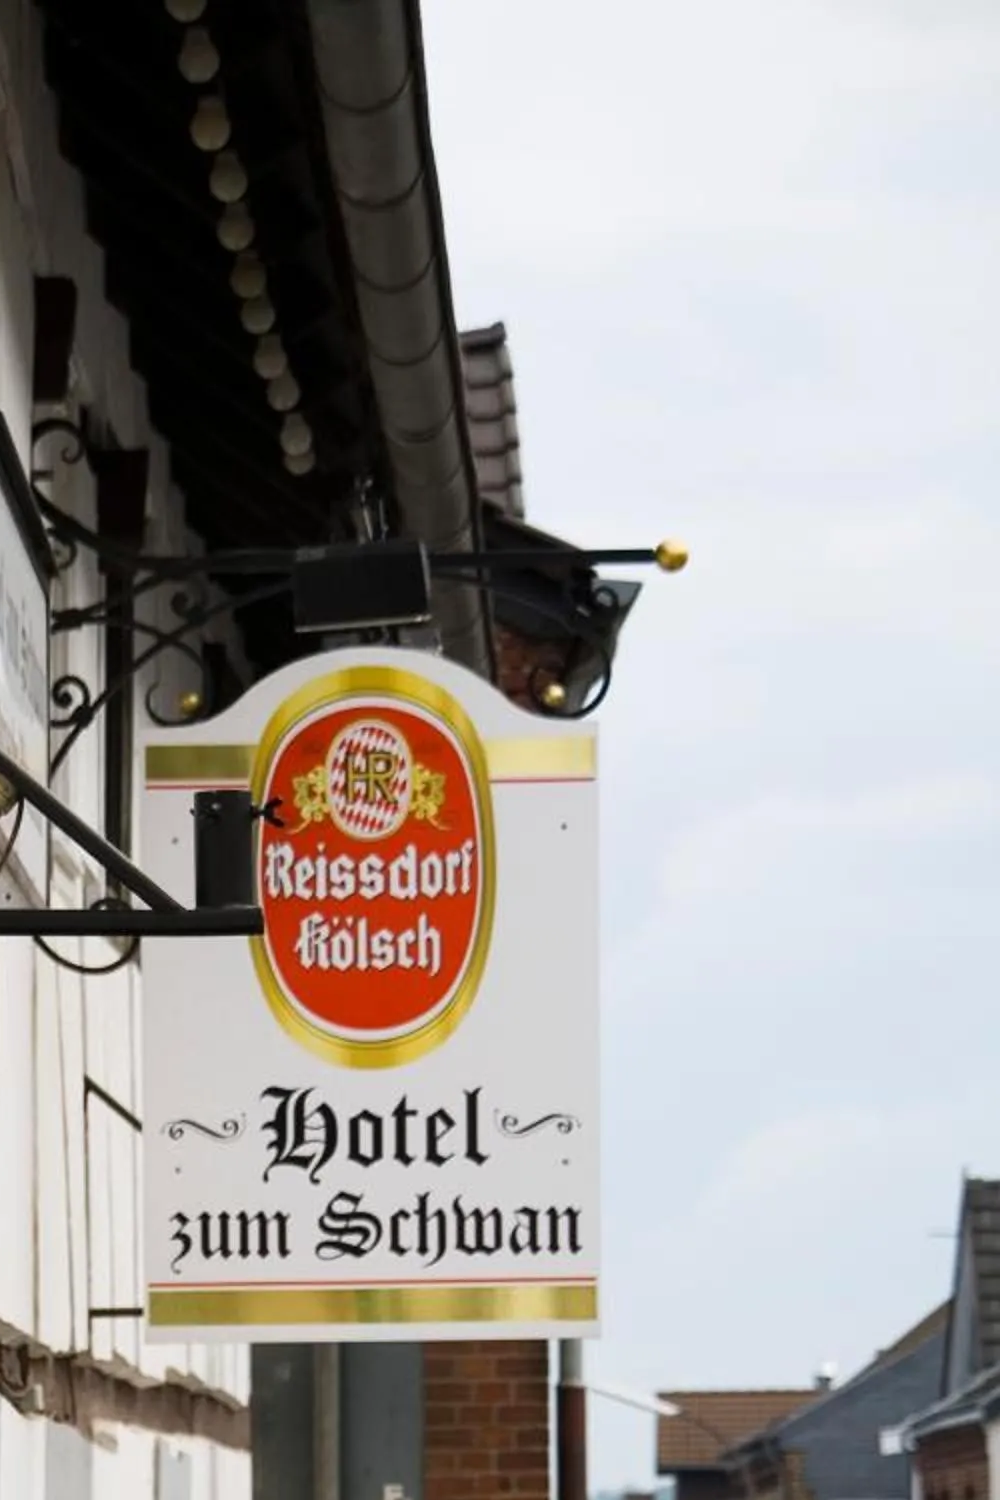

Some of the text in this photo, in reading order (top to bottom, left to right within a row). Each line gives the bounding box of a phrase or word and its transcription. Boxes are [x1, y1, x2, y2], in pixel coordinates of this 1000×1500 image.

[264, 838, 475, 899] Reissdorf
[294, 911, 442, 977] Kölsch
[260, 1086, 490, 1185] Hotel
[168, 1191, 582, 1274] zum Schwan
